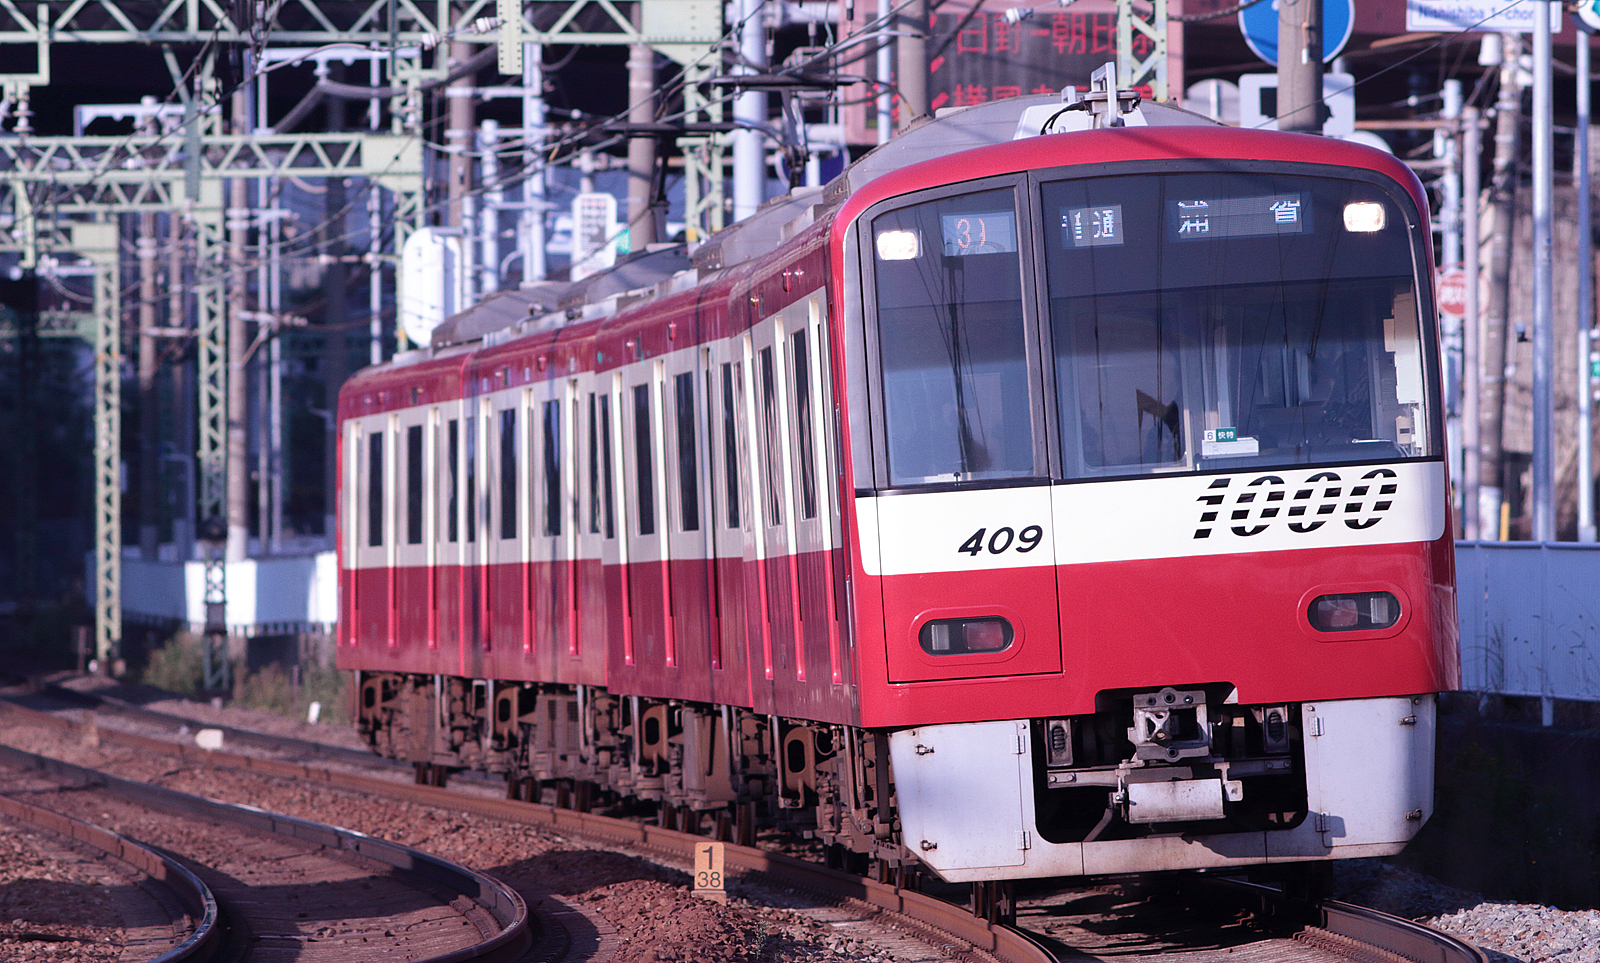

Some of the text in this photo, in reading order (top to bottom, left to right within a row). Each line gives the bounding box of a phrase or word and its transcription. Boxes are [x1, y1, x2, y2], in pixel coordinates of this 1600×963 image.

[1207, 431, 1213, 441] 6
[1193, 468, 1398, 539] 1000
[958, 524, 1043, 556] 409
[702, 846, 713, 870] 1
[697, 871, 721, 888] 38
